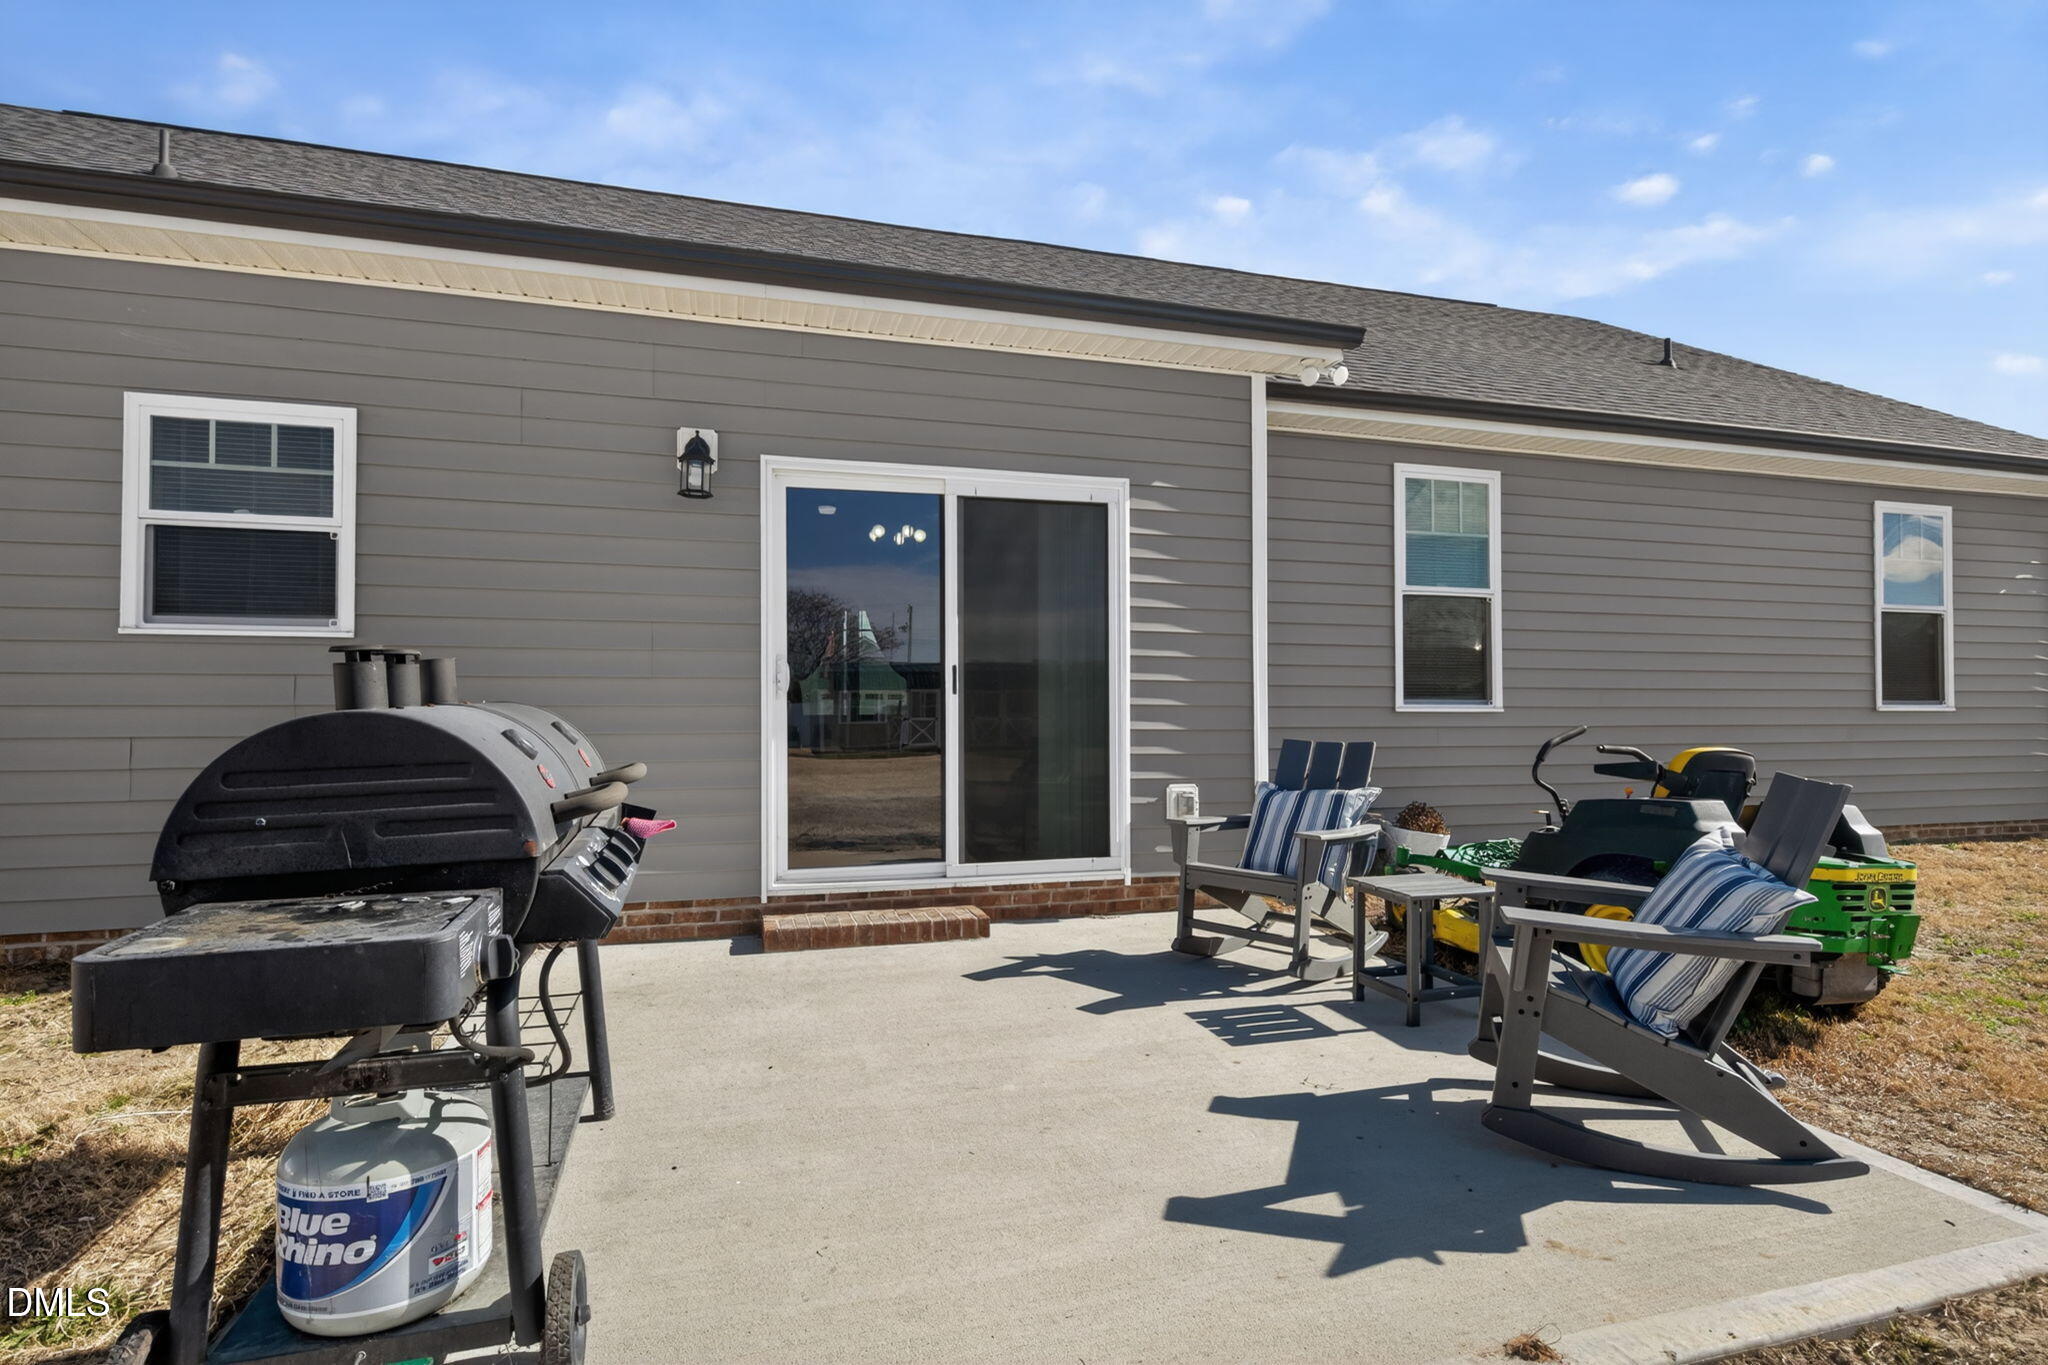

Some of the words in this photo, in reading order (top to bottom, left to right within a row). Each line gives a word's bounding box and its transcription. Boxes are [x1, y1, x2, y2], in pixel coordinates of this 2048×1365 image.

[298, 1190, 316, 1199] FIND
[318, 1191, 325, 1199] A
[328, 1188, 361, 1199] STORE
[279, 1202, 351, 1236] Blue
